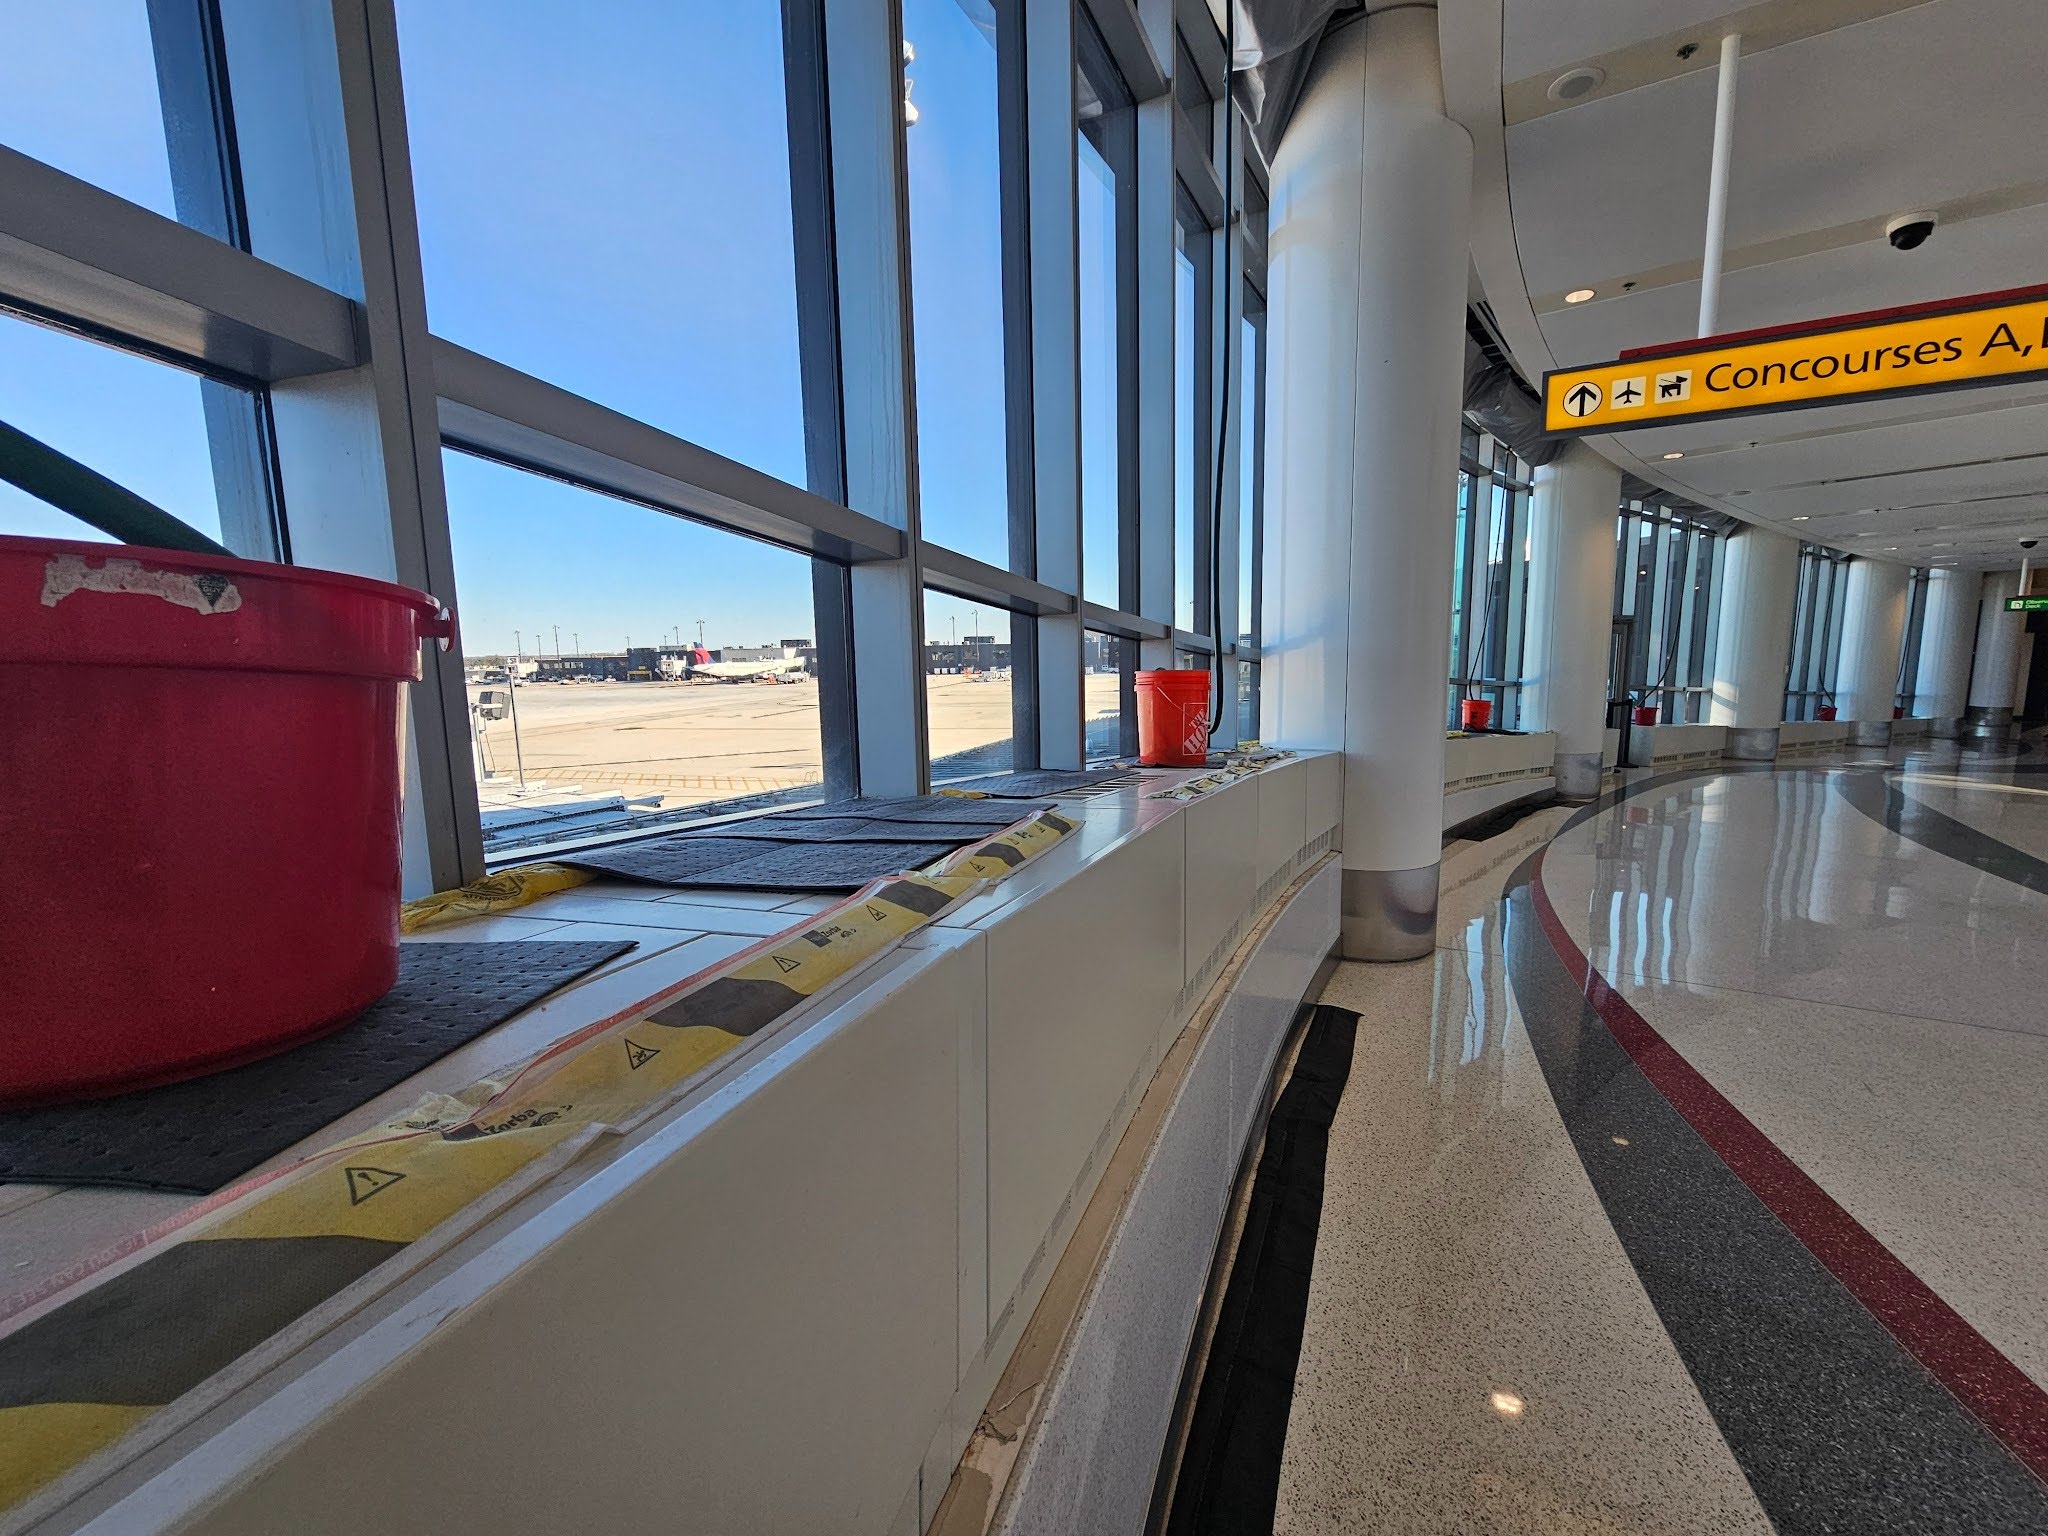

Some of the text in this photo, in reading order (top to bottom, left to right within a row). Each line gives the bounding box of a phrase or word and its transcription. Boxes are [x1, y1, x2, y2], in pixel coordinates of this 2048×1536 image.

[1705, 317, 2048, 393] Concourses A,
[484, 1107, 538, 1134] Zorba
